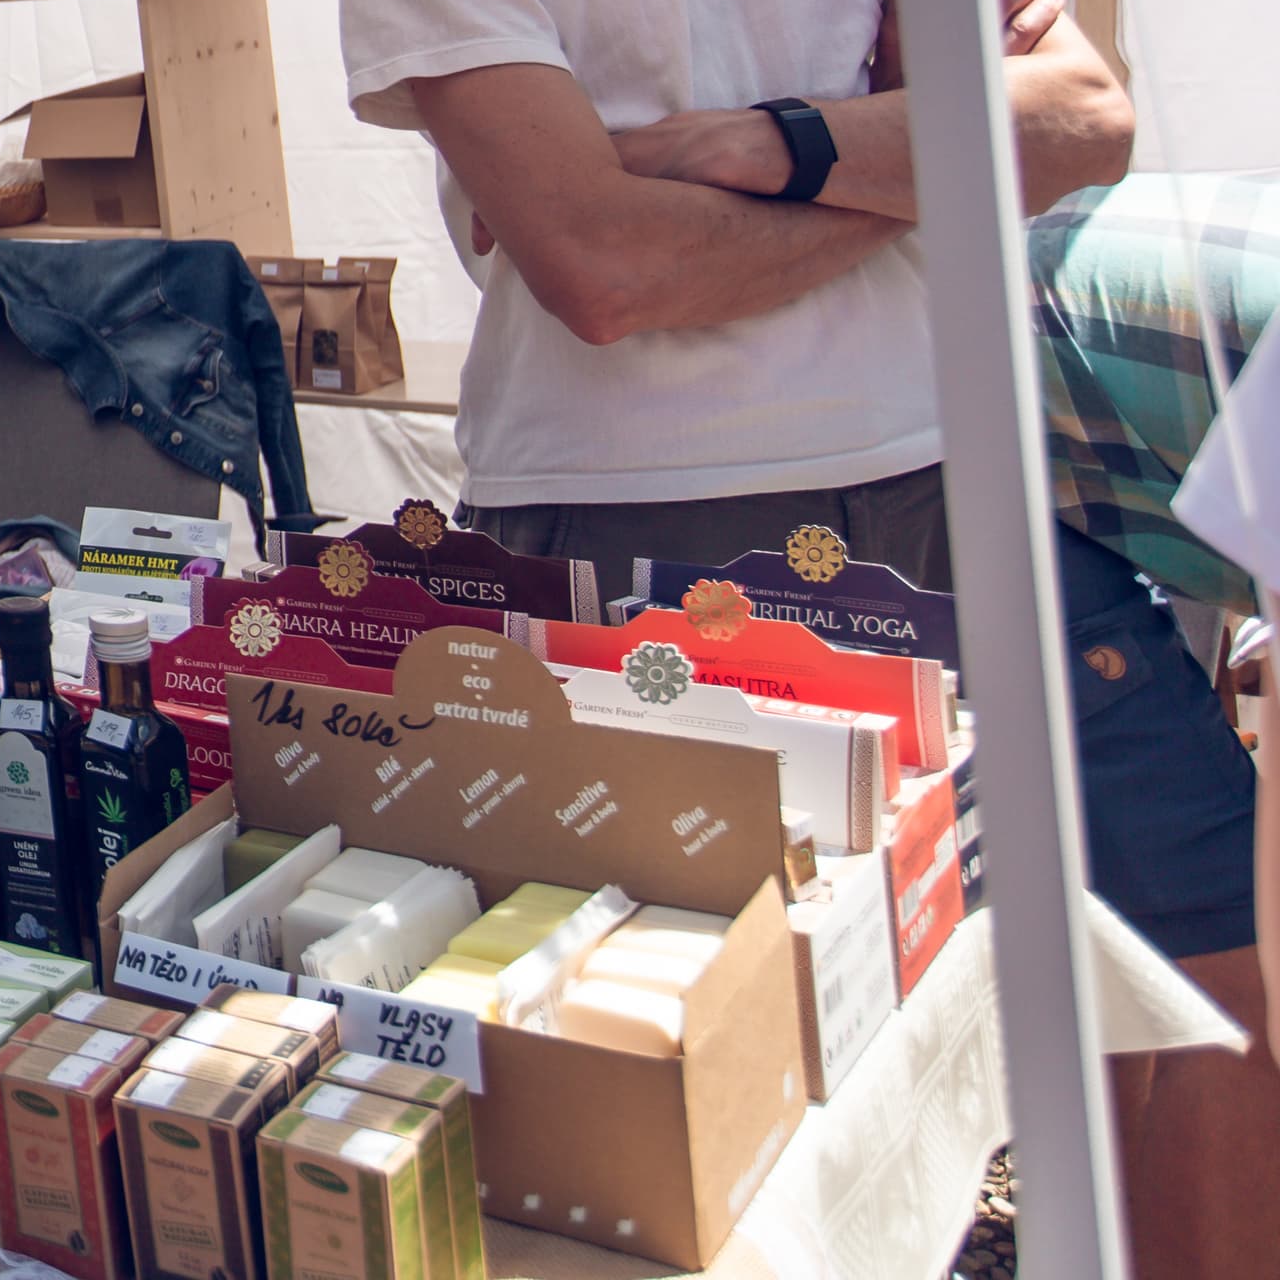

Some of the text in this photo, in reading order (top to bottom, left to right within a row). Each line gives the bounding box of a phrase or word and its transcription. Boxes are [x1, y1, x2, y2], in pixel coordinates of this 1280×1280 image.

[82, 550, 179, 571] NÁRAMEK HMT
[428, 577, 506, 603] SPICES
[745, 586, 811, 601] GARDEN FRESH
[285, 598, 318, 610] GARDEN
[847, 613, 919, 640] YOGA
[447, 640, 499, 660] natur
[183, 658, 216, 670] GARDEN
[462, 673, 491, 690] eco
[434, 700, 529, 728] extra tvrdé
[574, 701, 645, 719] GARDEN FRESH
[274, 741, 304, 768] Oliva
[374, 754, 402, 784] Bílé
[458, 767, 500, 805] Lemon
[554, 780, 609, 827] Sensitive
[670, 805, 708, 837] Oliva
[13, 840, 39, 852] LNĚNÝ
[17, 851, 38, 860] OLEJ
[118, 944, 146, 969] NA
[149, 950, 188, 983] TĚLO
[377, 1001, 454, 1042] VLASY
[377, 1031, 446, 1068] TĚLO
